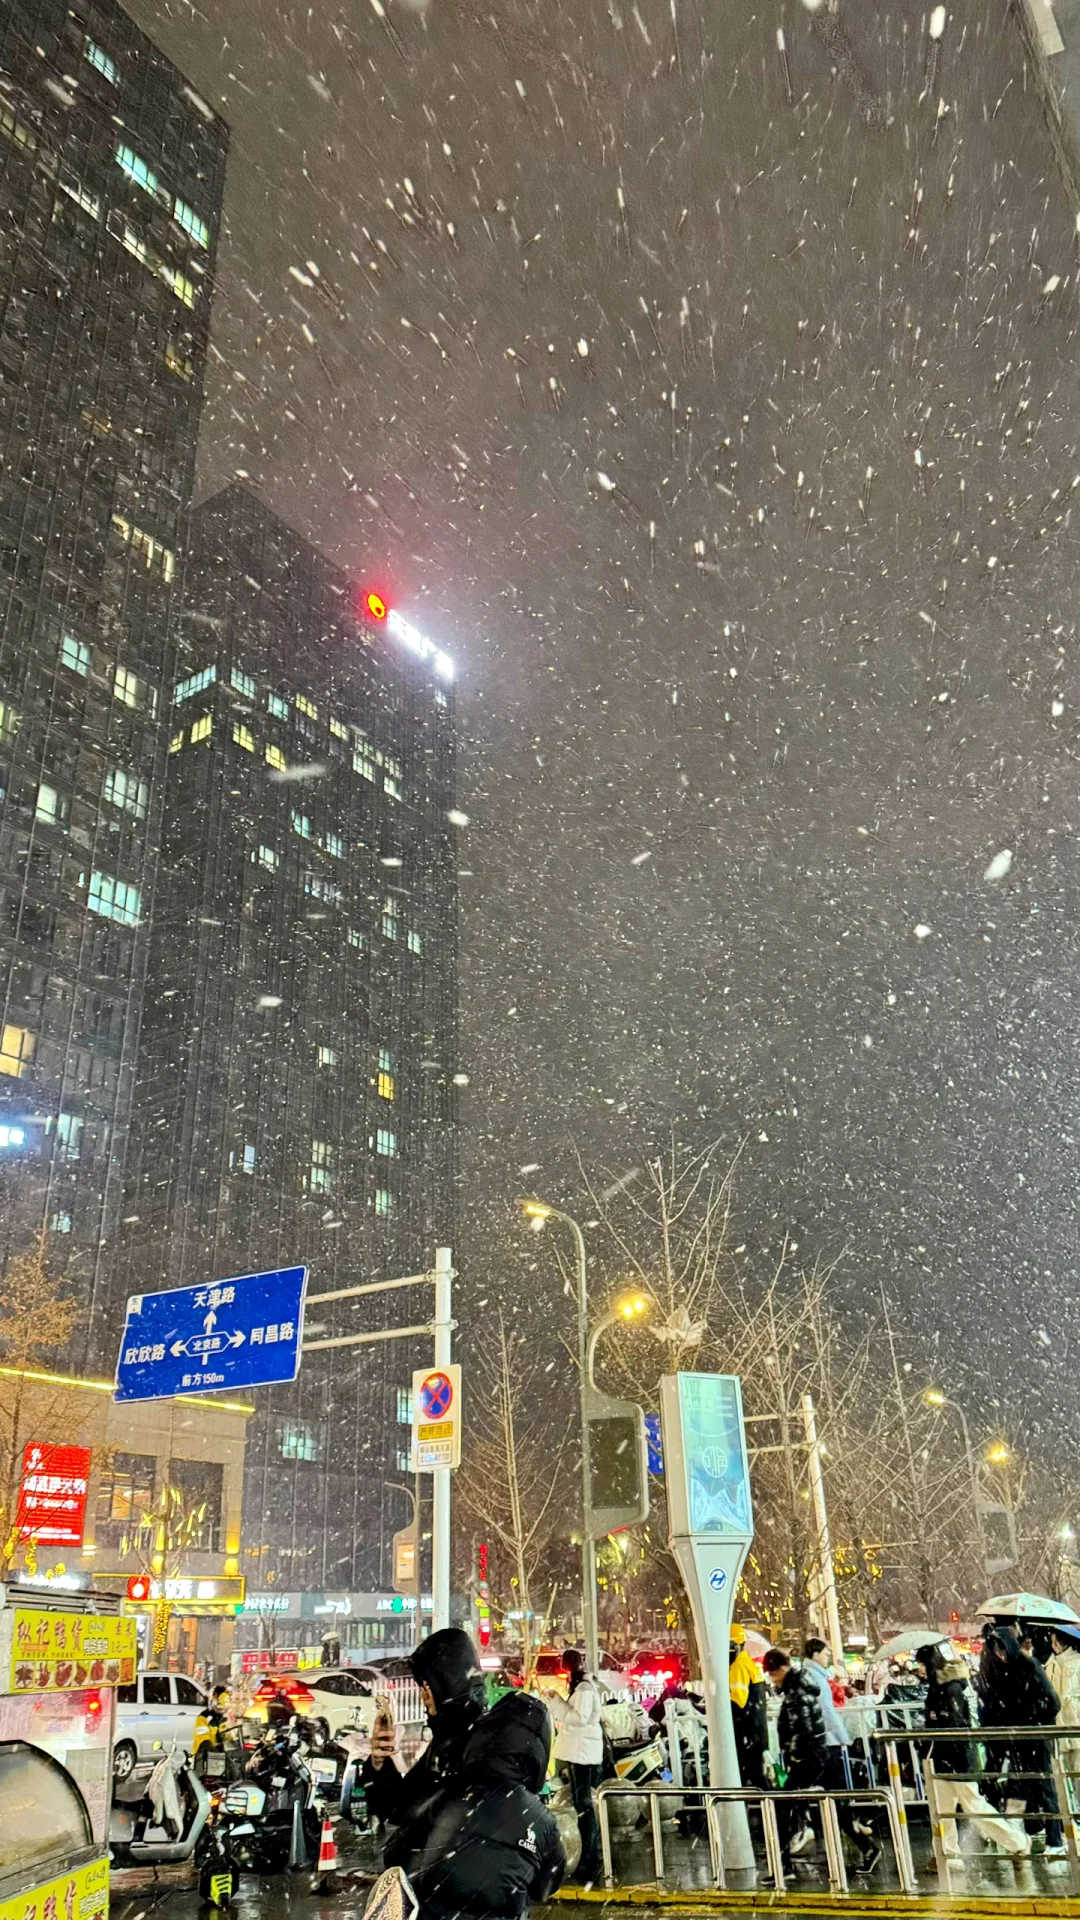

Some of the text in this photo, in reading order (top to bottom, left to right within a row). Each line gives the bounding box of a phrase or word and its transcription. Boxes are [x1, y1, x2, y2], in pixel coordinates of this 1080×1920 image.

[193, 1287, 235, 1308] 天津路
[250, 1322, 294, 1345] 同昌路
[124, 1343, 165, 1365] 欣欣路
[192, 1338, 221, 1351] 北京路
[182, 1373, 224, 1387] 前方150m
